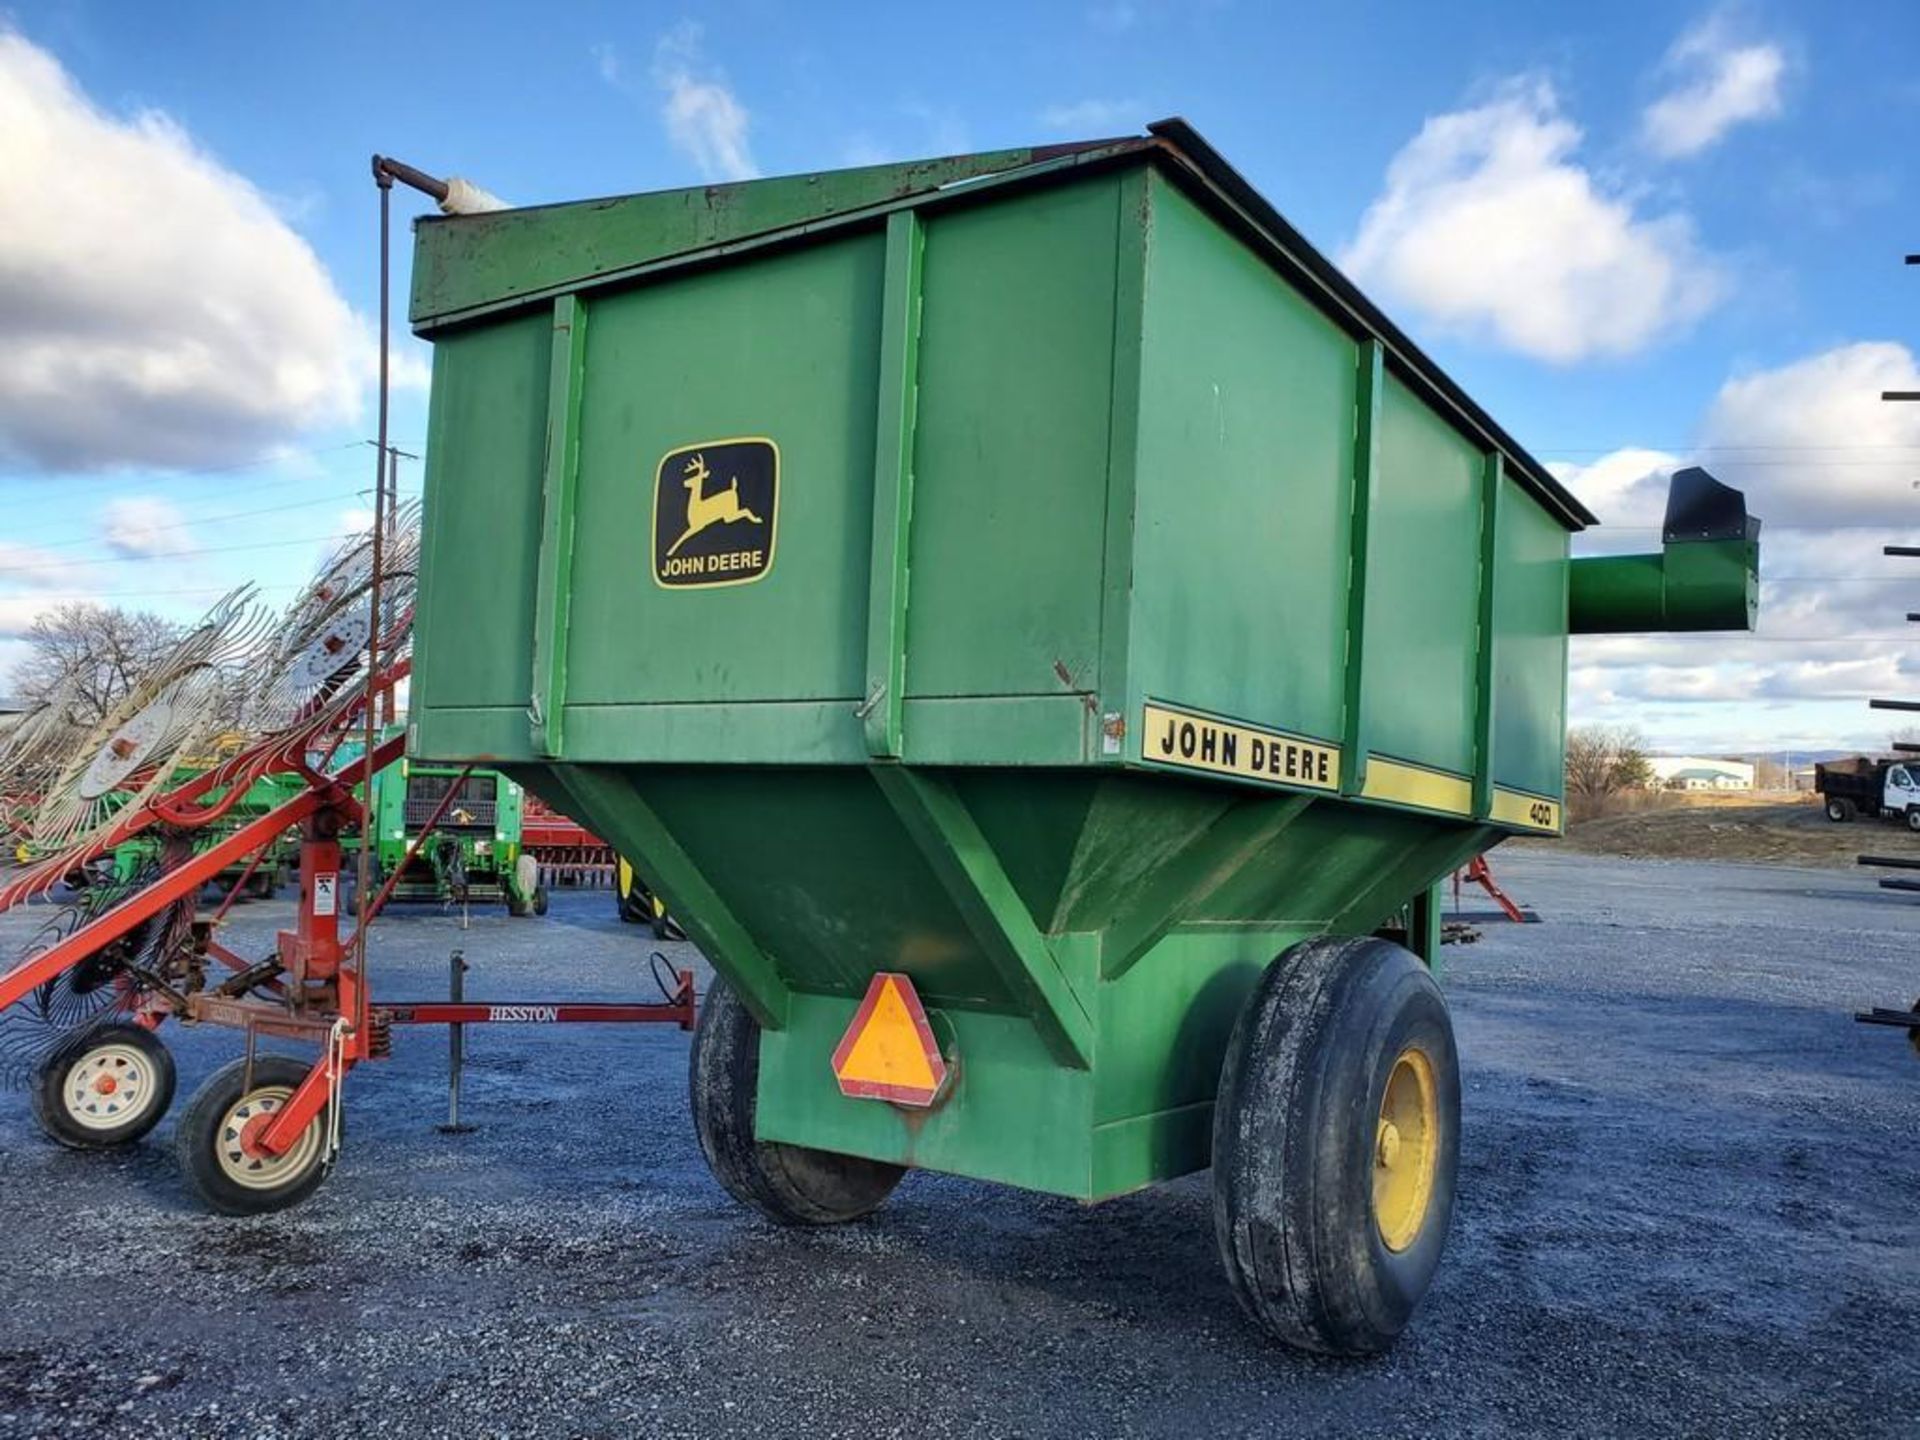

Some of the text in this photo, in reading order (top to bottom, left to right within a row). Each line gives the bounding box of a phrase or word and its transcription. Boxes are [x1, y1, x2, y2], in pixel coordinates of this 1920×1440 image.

[661, 550, 763, 577] JOHN DEERE
[1162, 720, 1237, 766] JOHN
[1251, 738, 1329, 782] DEERE
[1530, 802, 1551, 826] 400
[489, 1006, 558, 1021] HESSTON
